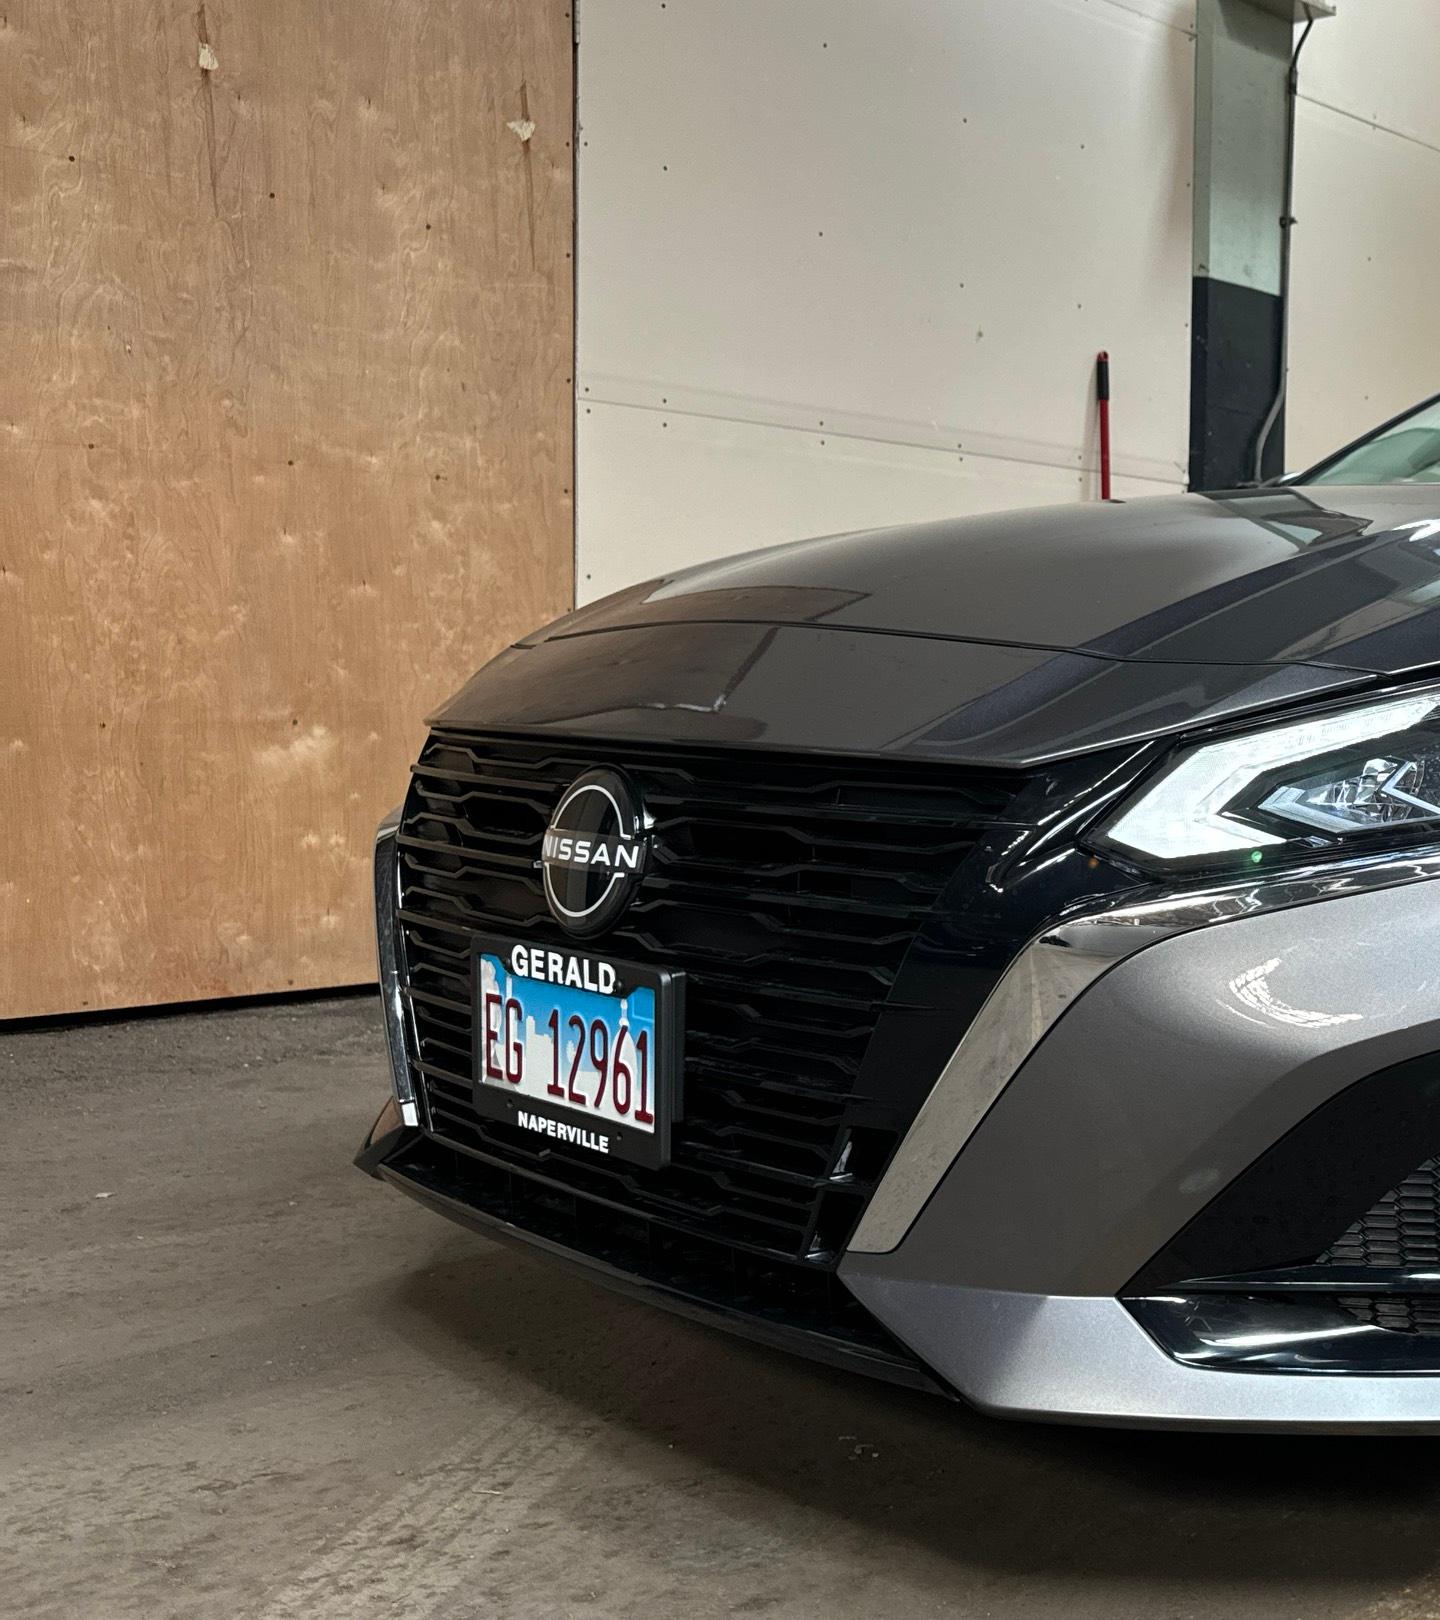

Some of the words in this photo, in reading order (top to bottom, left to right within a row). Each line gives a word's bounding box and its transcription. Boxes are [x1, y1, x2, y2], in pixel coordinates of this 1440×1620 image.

[543, 838, 640, 870] NISSAN
[511, 943, 617, 995] GERALD
[485, 992, 524, 1084] EG
[547, 1008, 655, 1125] 12961
[517, 1109, 610, 1154] NAPERVILLE
